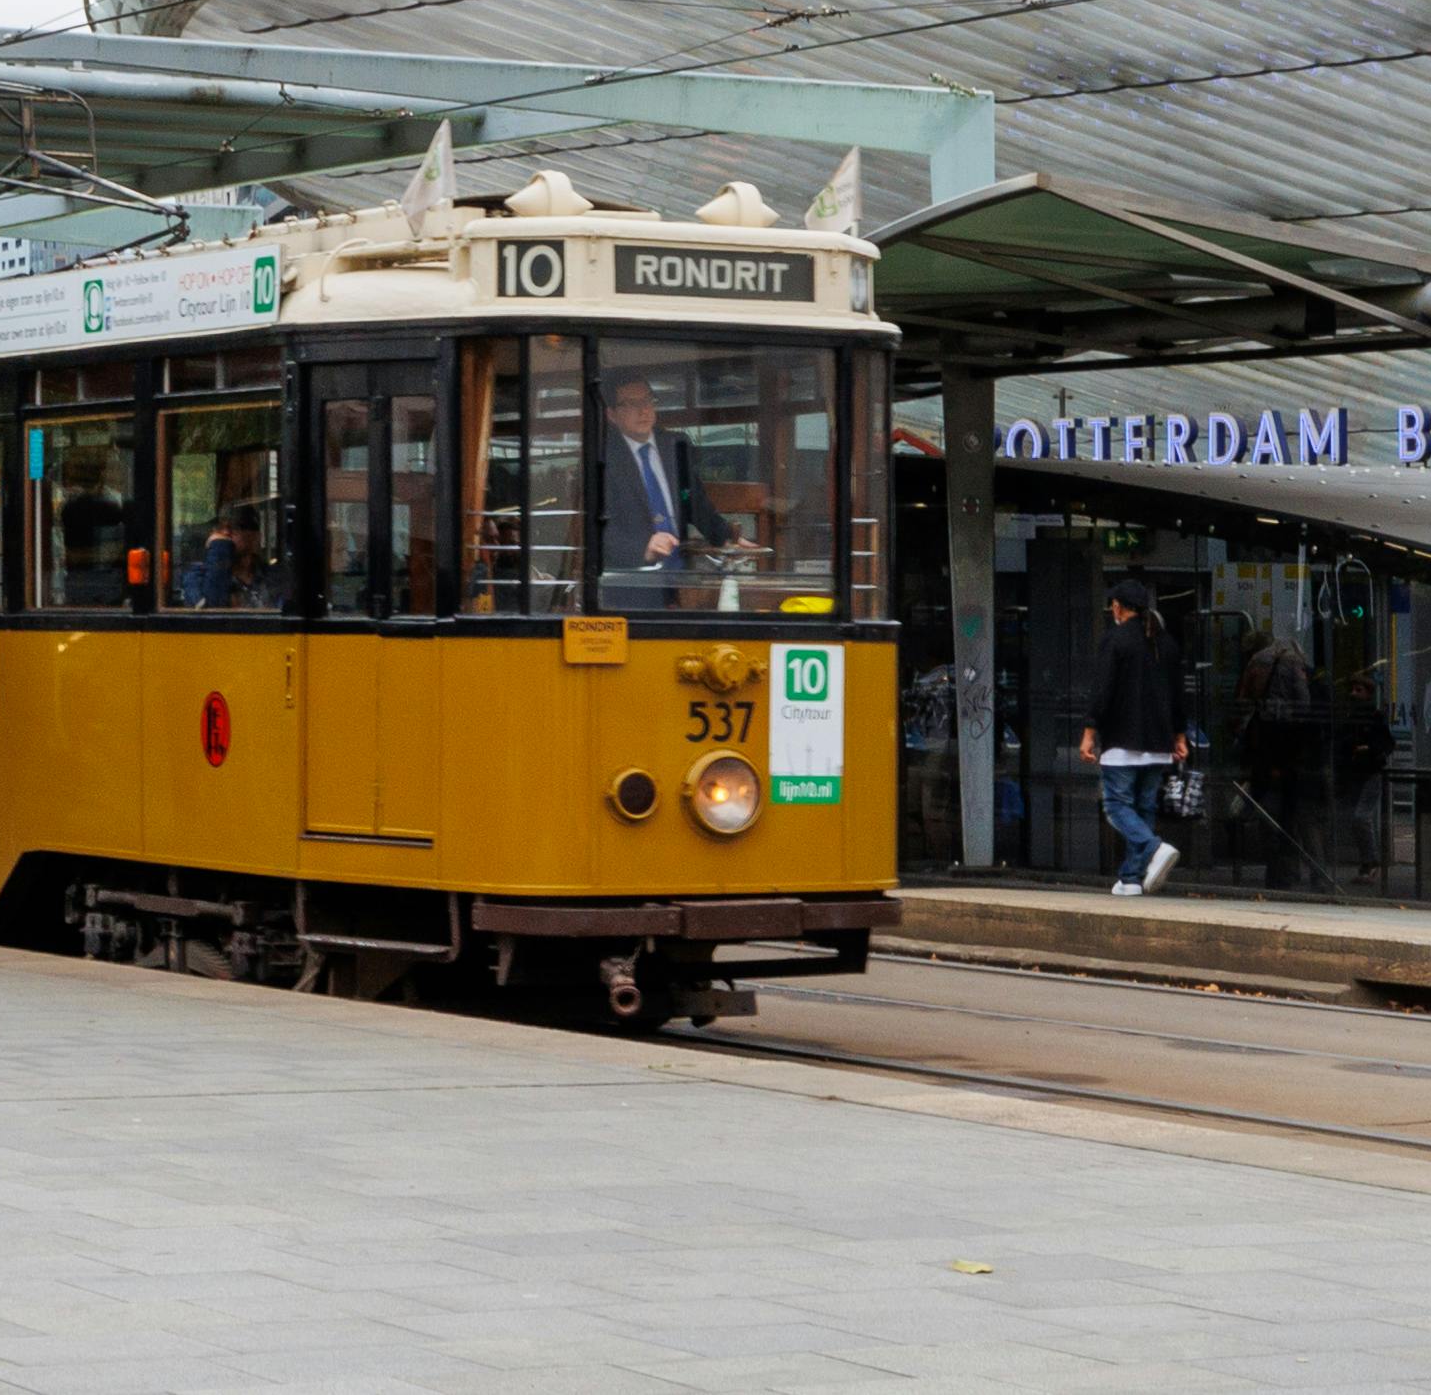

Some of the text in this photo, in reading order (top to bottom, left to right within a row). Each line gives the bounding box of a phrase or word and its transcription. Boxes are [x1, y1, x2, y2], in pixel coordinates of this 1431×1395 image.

[255, 265, 274, 305] 10
[501, 244, 563, 297] 10
[634, 253, 790, 293] RONDRIT
[220, 292, 236, 317] Lijn
[993, 406, 1348, 466] OTTERDAM
[788, 658, 827, 695] 10
[685, 701, 755, 743] 537
